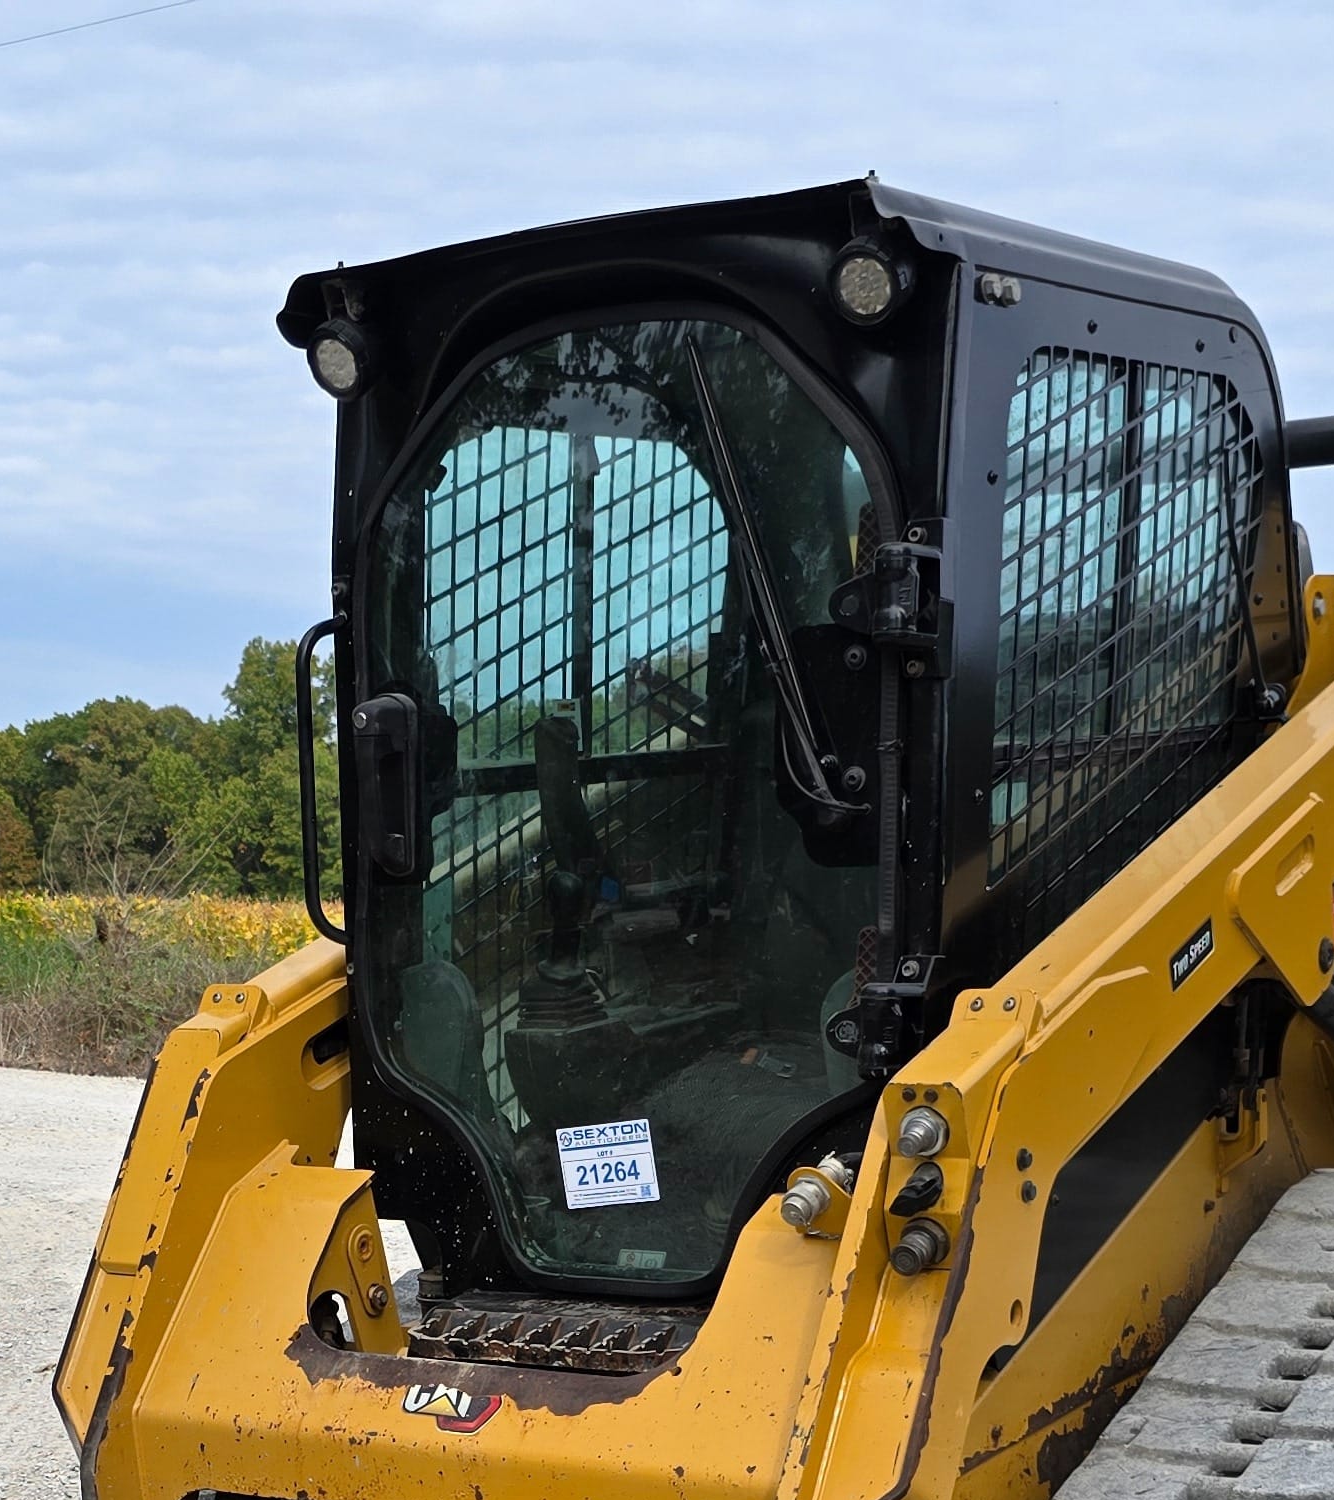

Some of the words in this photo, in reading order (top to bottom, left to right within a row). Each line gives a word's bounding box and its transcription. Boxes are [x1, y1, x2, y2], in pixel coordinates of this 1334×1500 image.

[573, 1122, 647, 1140] SEXTON
[574, 1134, 649, 1146] AUCTIONEERS
[576, 1159, 640, 1186] 21264
